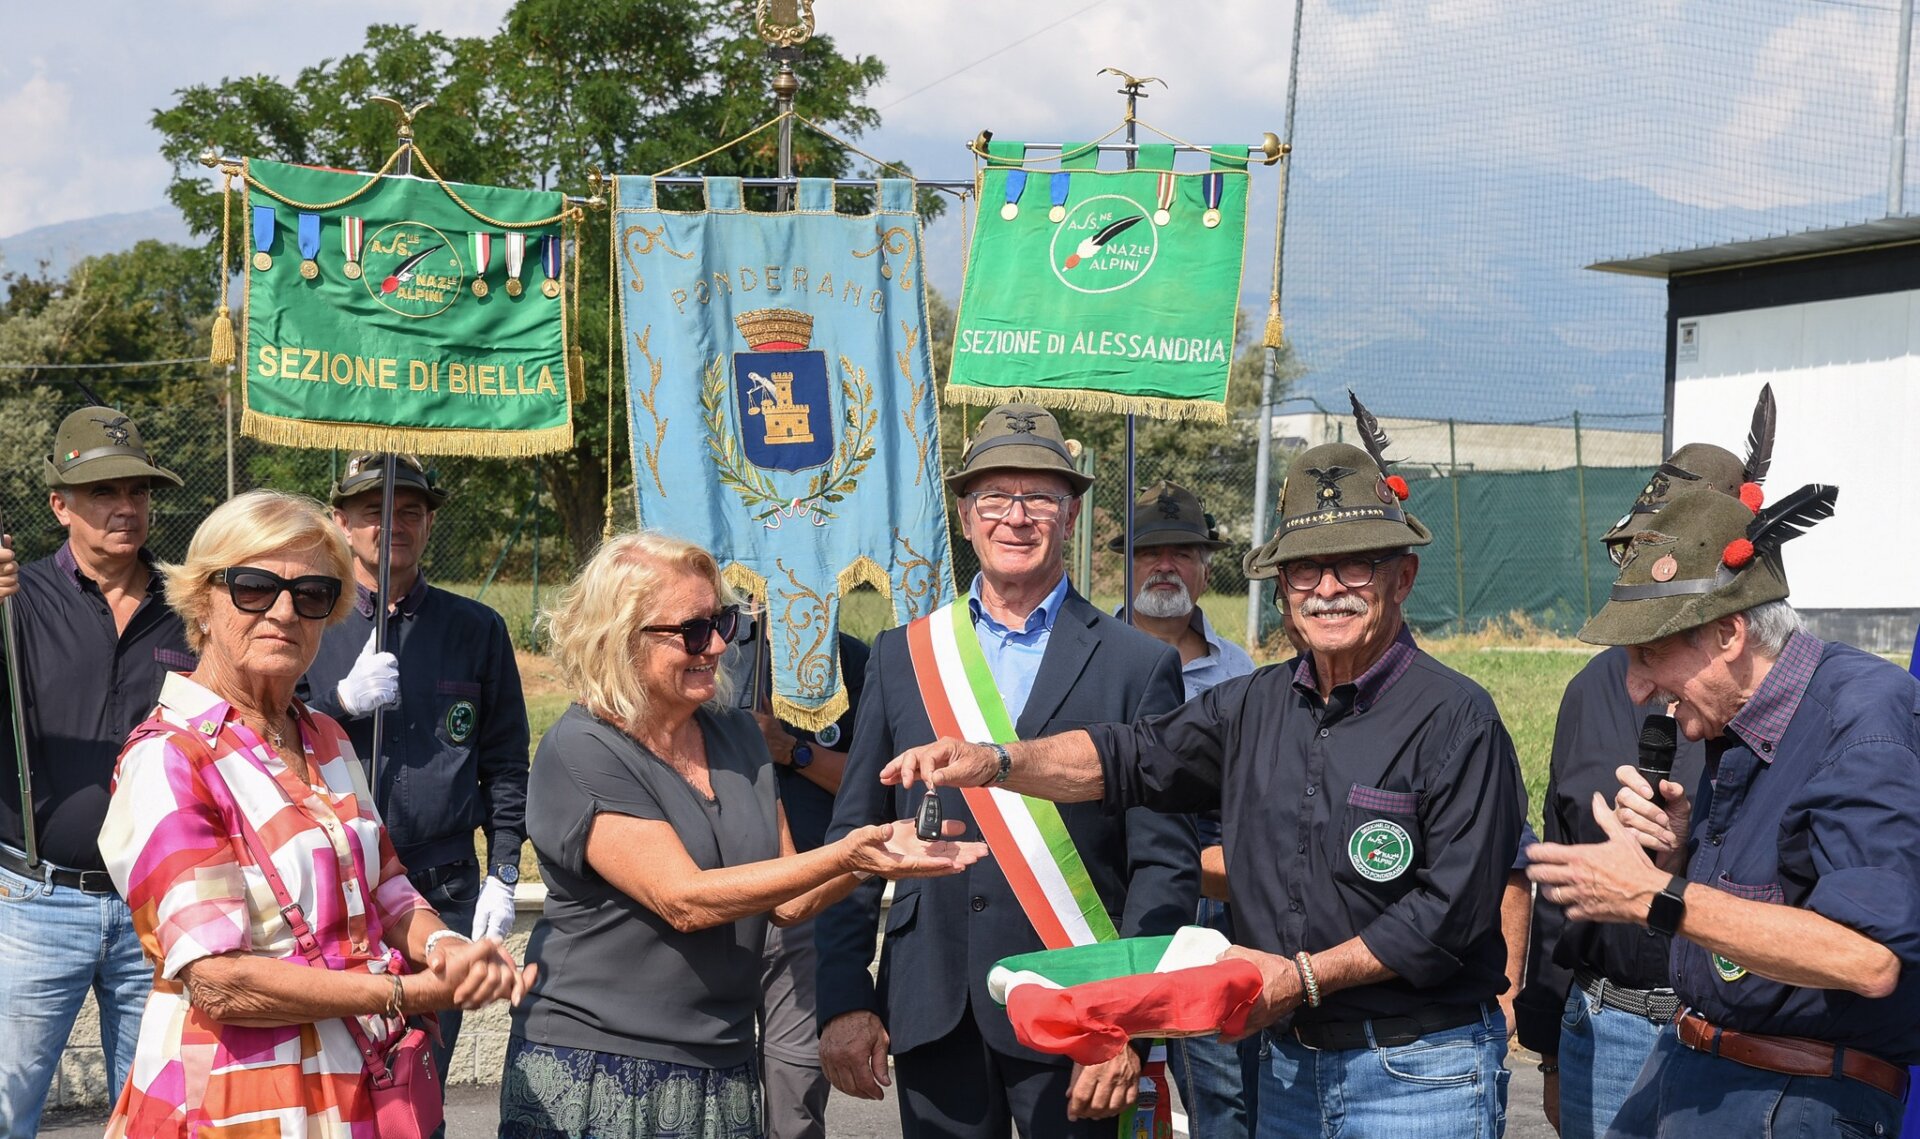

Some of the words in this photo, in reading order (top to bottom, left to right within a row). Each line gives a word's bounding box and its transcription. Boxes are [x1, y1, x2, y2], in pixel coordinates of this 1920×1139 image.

[1089, 258, 1140, 272] ALPINI
[396, 287, 444, 303] ALPINI
[671, 265, 885, 314] PONDERANO
[959, 330, 1042, 355] SEZIONE
[1047, 334, 1065, 354] DI
[1070, 331, 1226, 362] ALESSANDRIA
[258, 345, 398, 390] SEZIONE
[409, 360, 438, 392] DI
[449, 363, 558, 396] BIELLA
